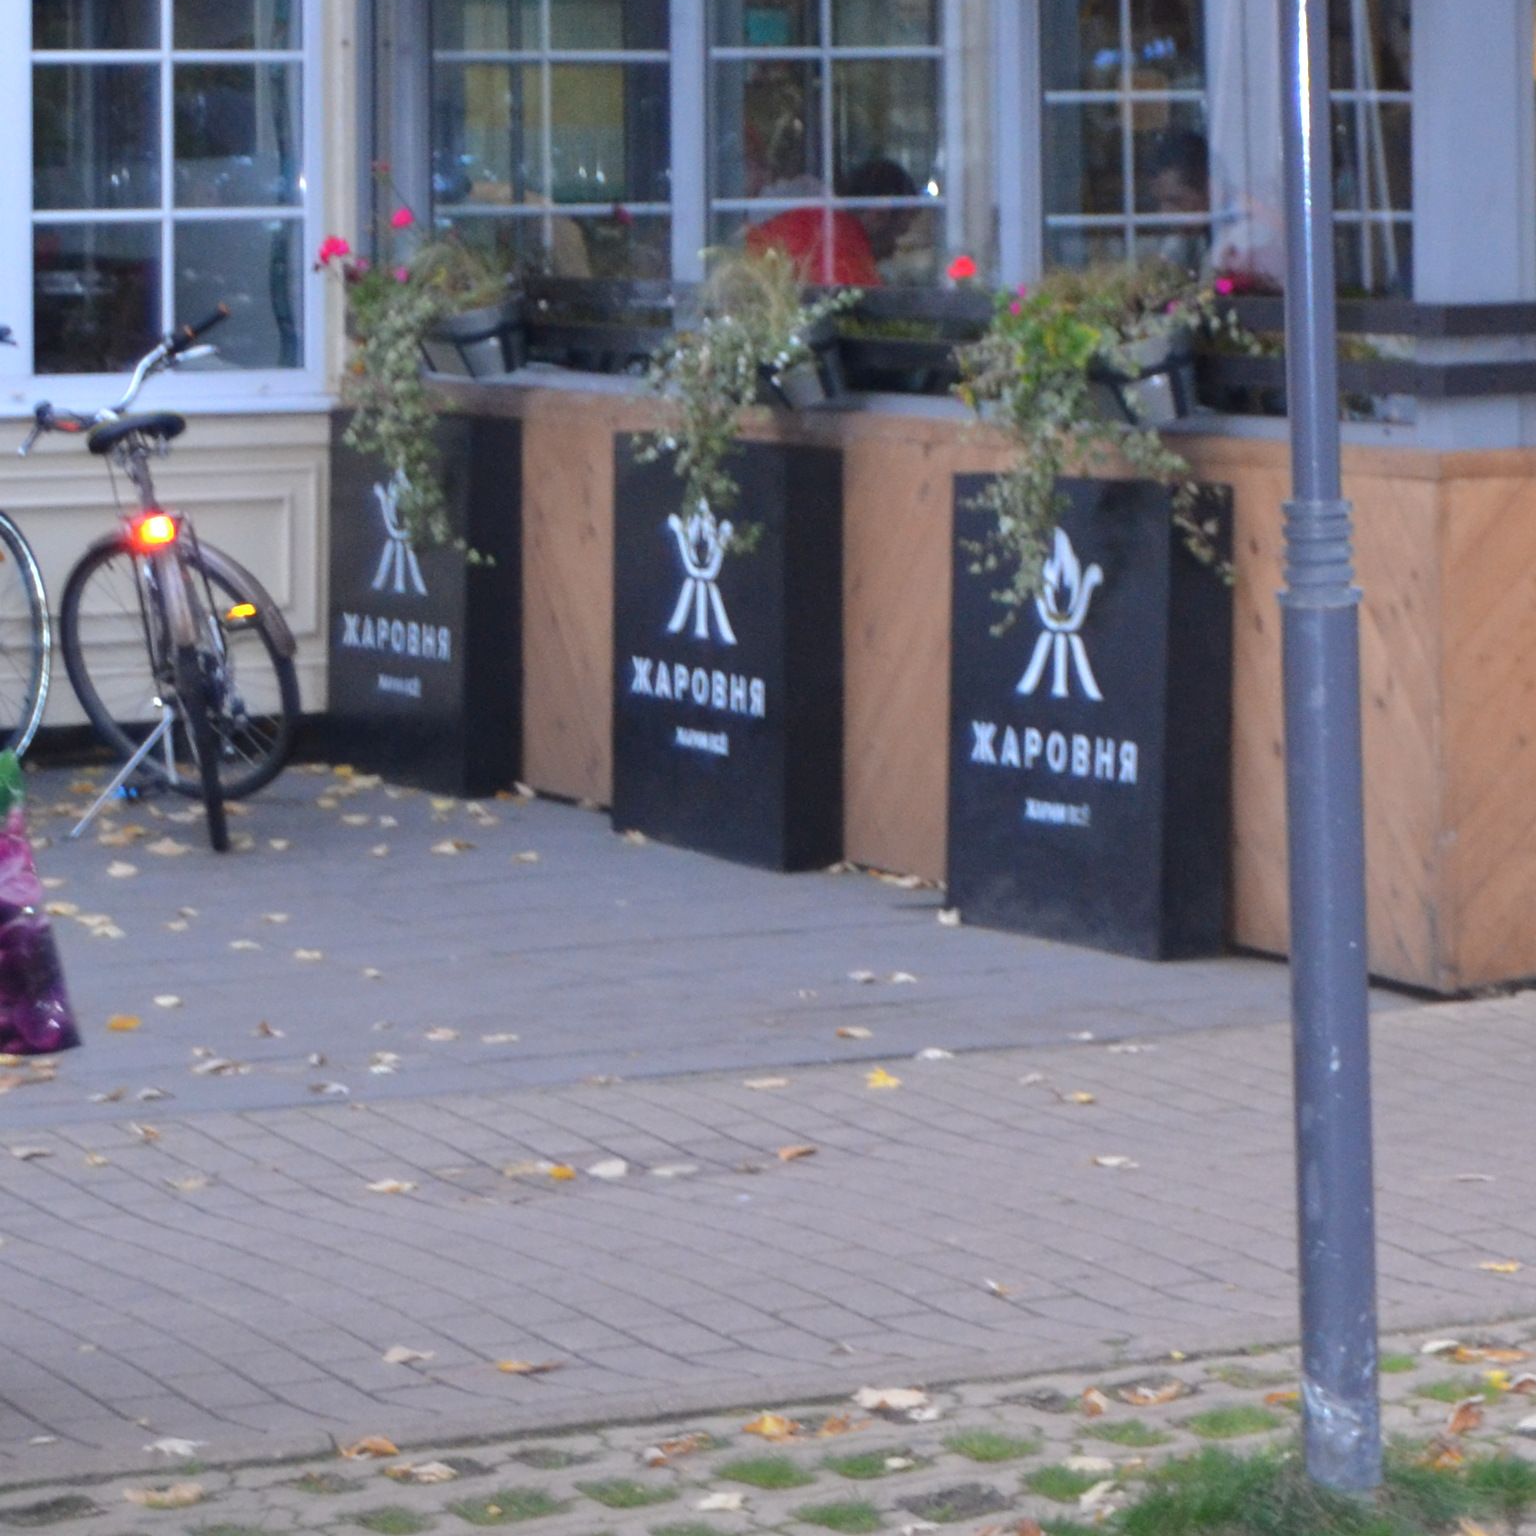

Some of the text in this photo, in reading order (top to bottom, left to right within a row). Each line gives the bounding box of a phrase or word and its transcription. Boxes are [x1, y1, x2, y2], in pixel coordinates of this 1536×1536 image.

[341, 611, 452, 662] ЖАРОВНЯ
[630, 655, 766, 719] ЖАРОВНЯ
[971, 720, 1139, 785] ЖАРОВНЯ
